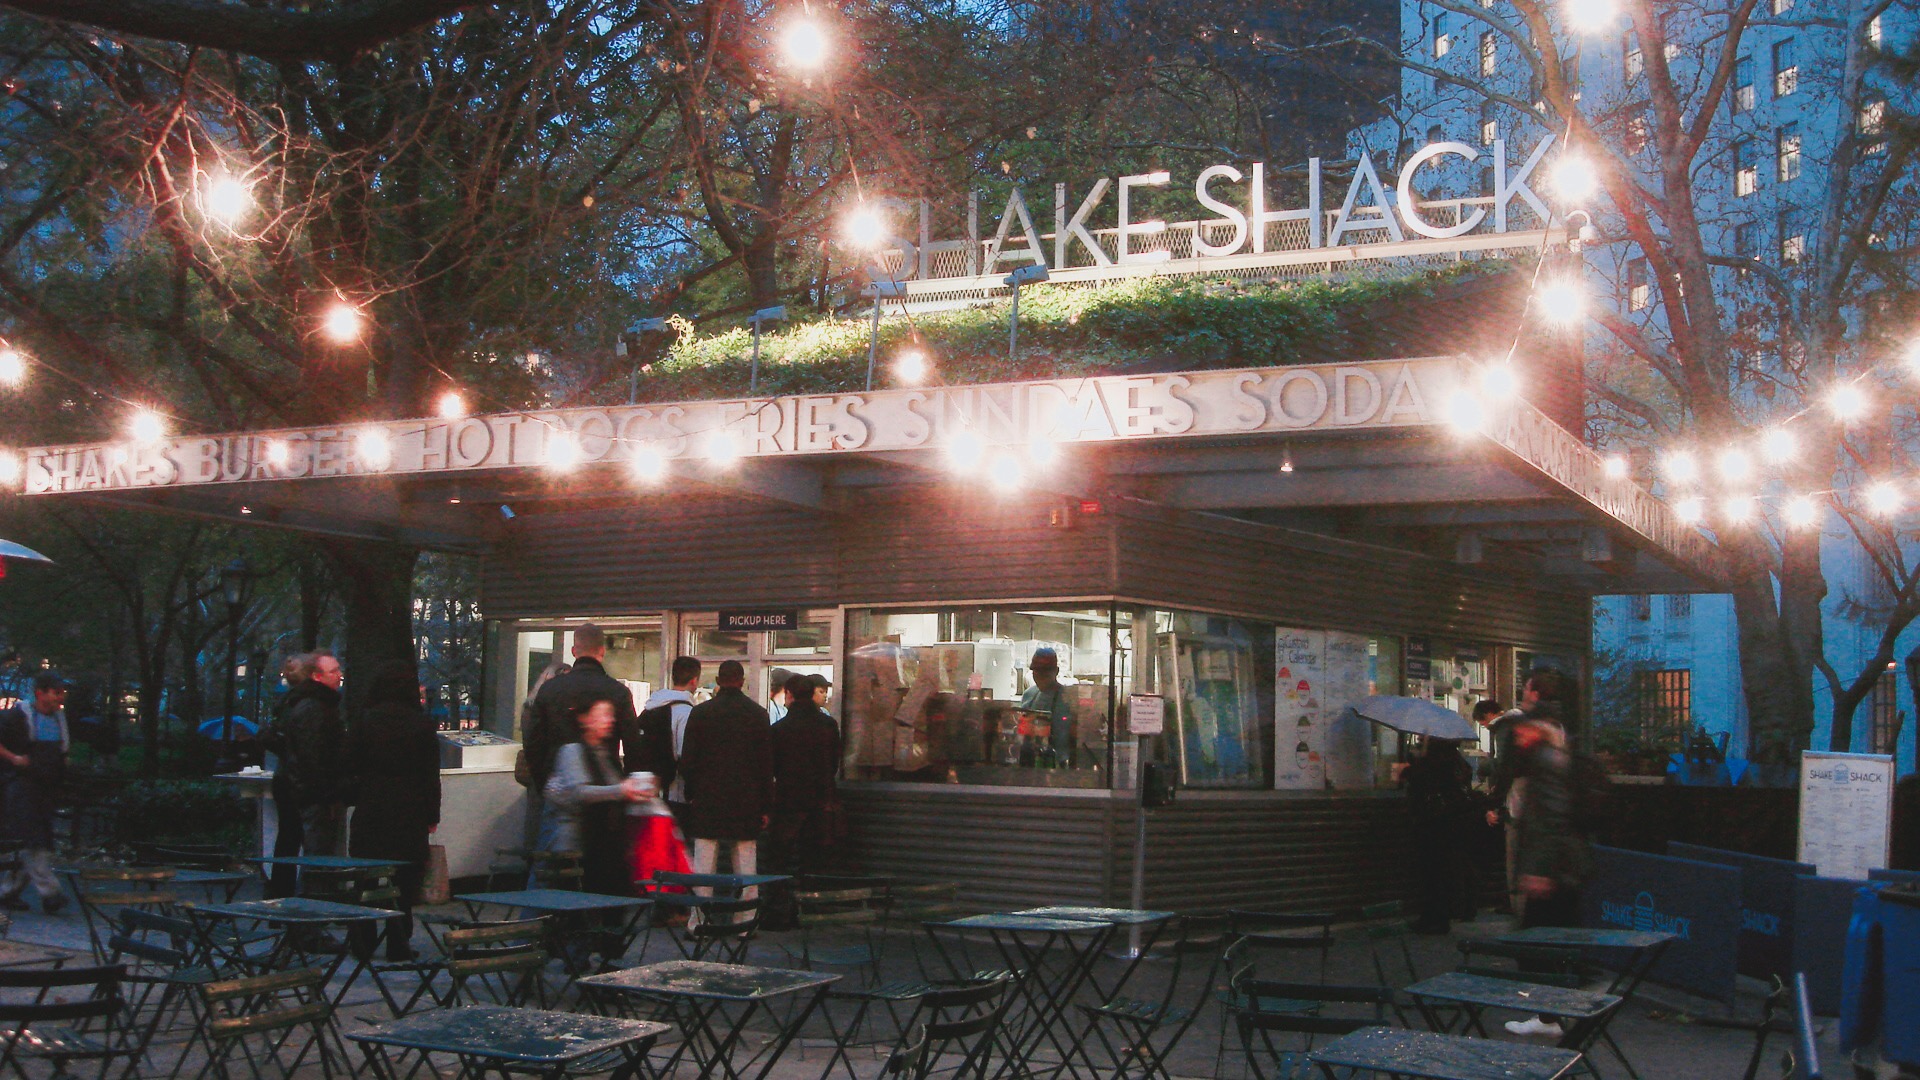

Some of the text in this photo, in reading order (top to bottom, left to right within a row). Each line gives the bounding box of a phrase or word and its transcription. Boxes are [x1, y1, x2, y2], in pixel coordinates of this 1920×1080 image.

[1195, 133, 1563, 257] SHACK
[27, 439, 179, 494] SHAKES
[416, 414, 528, 471] HOT
[716, 394, 875, 453] FRIES
[900, 374, 1195, 447] SUNDAES
[1231, 362, 1431, 432] SODA
[729, 615, 787, 626] PICKUP HERE
[1810, 769, 1882, 783] SHAKE SHACK
[1601, 900, 1691, 940] SHAKE SHACK
